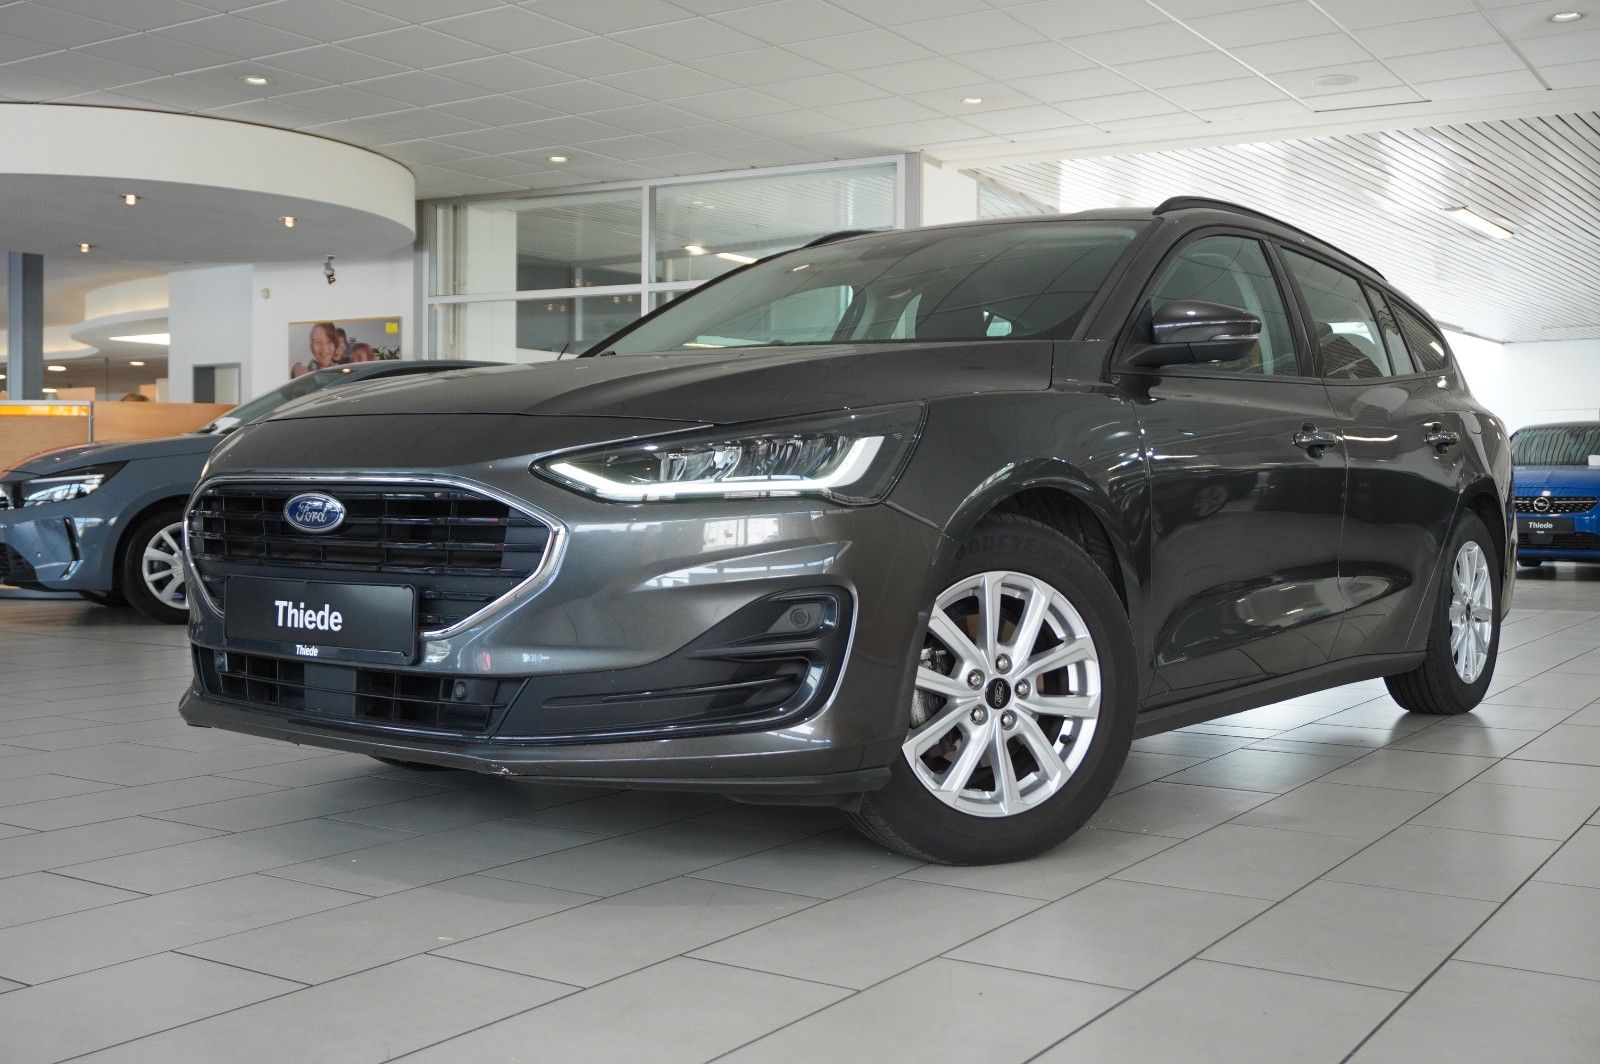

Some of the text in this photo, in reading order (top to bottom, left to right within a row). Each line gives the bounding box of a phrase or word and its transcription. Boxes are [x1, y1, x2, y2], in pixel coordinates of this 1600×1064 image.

[296, 500, 328, 522] Ford
[1528, 521, 1554, 529] Thiede
[274, 599, 343, 632] Thiede
[295, 644, 319, 657] Thiede
